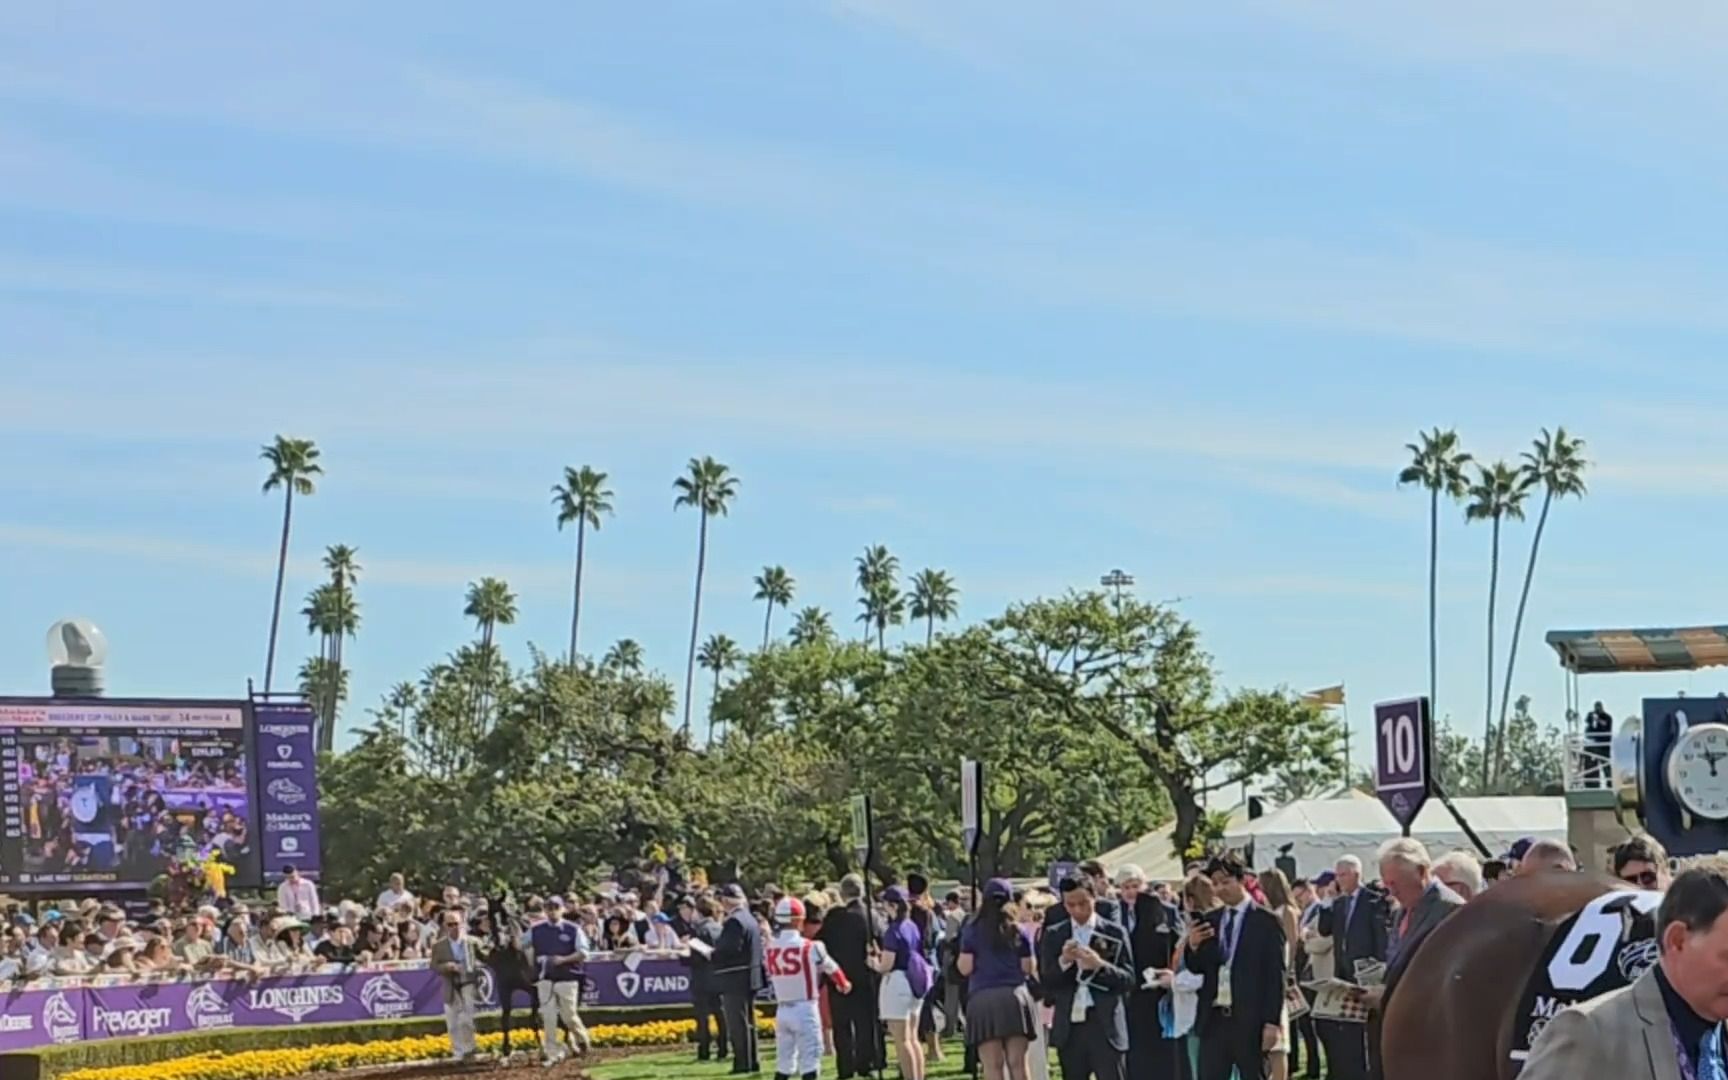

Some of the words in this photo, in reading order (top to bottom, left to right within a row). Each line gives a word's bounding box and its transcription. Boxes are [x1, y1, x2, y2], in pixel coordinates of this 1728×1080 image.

[1381, 714, 1415, 775] 10
[1547, 890, 1664, 991] 6
[767, 947, 801, 976] KS
[250, 985, 344, 1010] LONGINES
[644, 976, 689, 993] FAND
[92, 1006, 172, 1036] Prevagen
